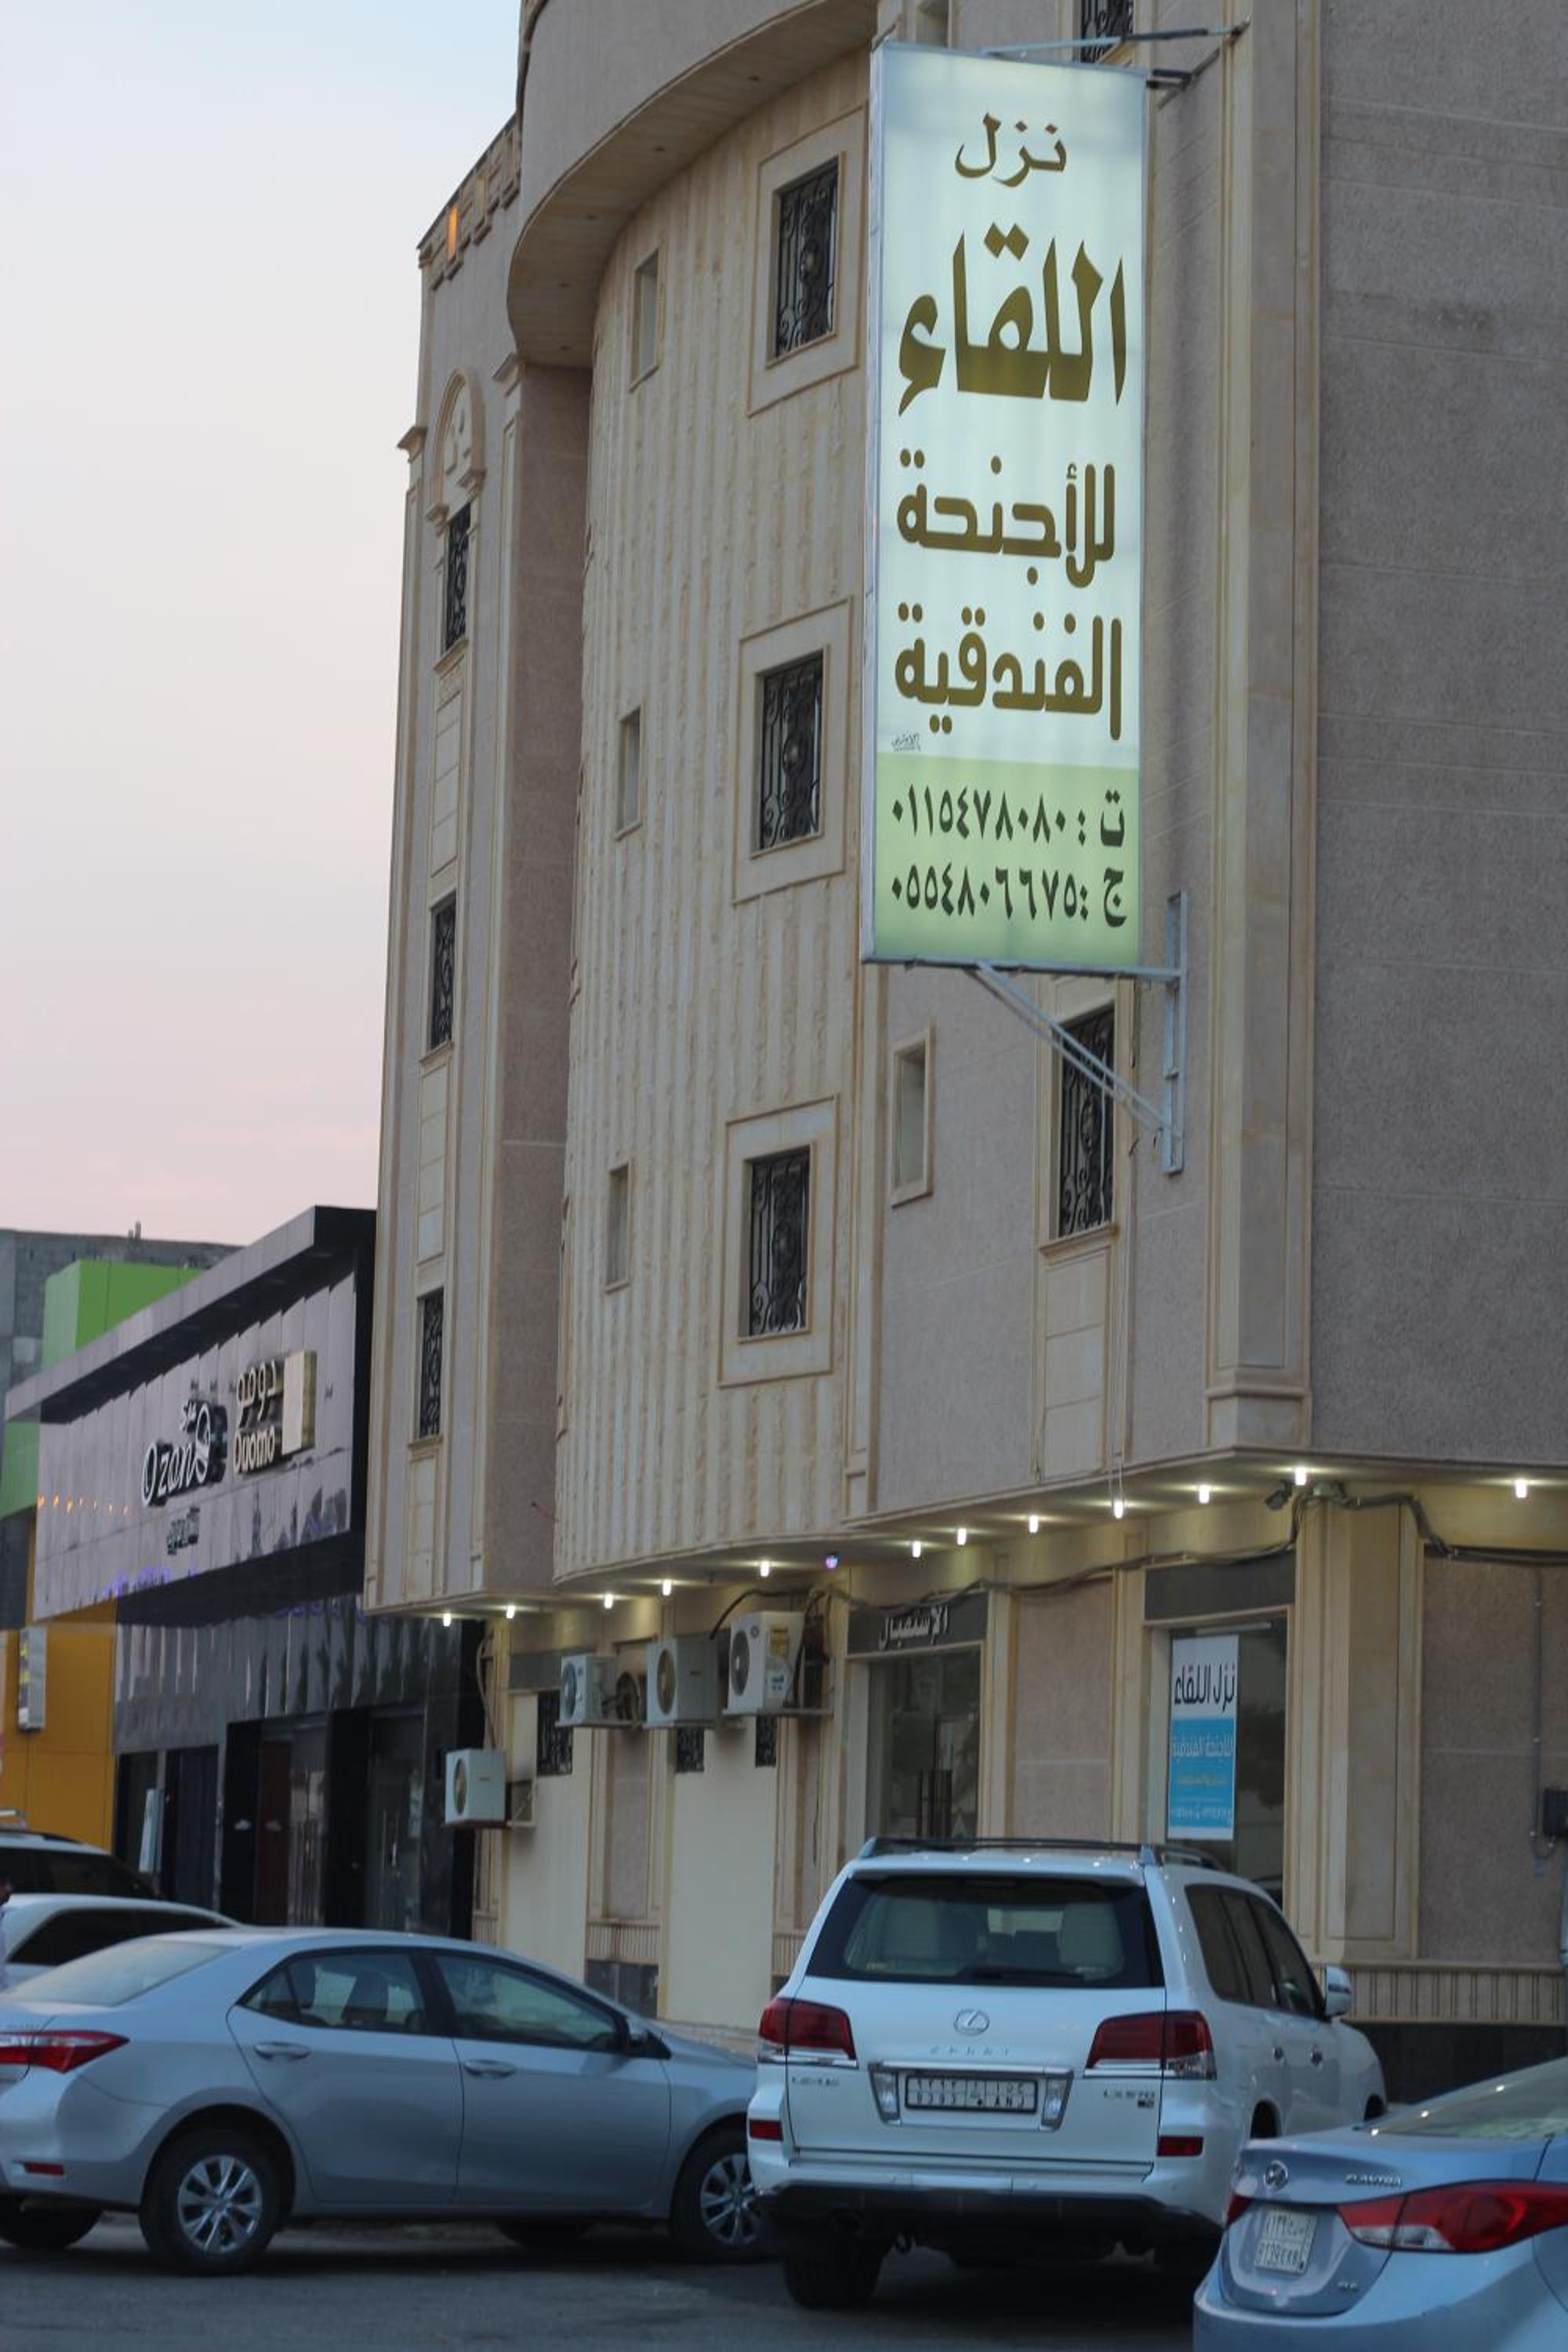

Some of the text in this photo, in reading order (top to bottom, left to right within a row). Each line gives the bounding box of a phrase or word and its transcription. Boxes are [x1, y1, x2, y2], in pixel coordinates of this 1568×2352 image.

[955, 112, 1067, 187] نزل
[898, 222, 1127, 417] اللقاء
[897, 448, 1116, 588] للأجنحة
[895, 602, 1122, 741] الفندقية
[1174, 1662, 1211, 1704] اللقاء
